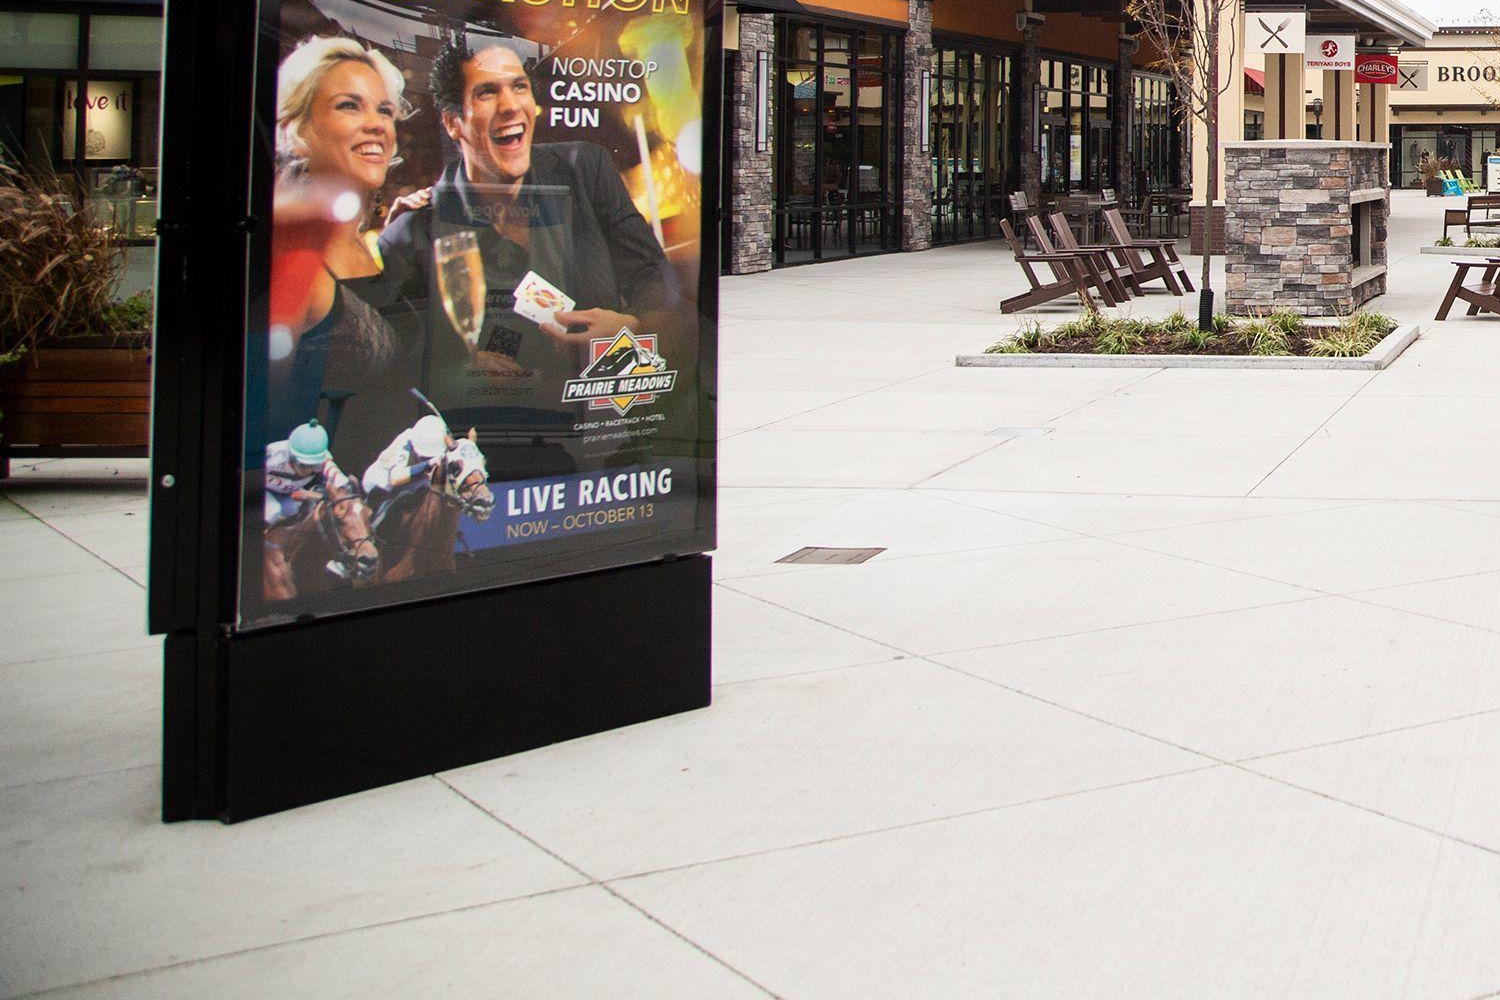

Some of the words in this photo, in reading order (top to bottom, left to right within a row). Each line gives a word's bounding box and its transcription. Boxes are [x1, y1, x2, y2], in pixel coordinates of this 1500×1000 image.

[552, 57, 658, 79] NONSTOP
[1358, 61, 1396, 75] CHARLEYS
[115, 92, 128, 112] it
[550, 80, 641, 103] CASINO
[550, 107, 599, 128] FUN
[567, 381, 615, 398] PRAIRIE
[617, 375, 672, 393] MEADOWS
[573, 421, 600, 431] CASINO
[605, 416, 640, 427] RACETRACK
[645, 413, 666, 422] HOTEL
[507, 483, 566, 517] LIVE
[578, 467, 672, 507] RACING
[507, 520, 549, 540] NOW
[563, 506, 635, 531] OCTOBER
[638, 503, 654, 519] 13
